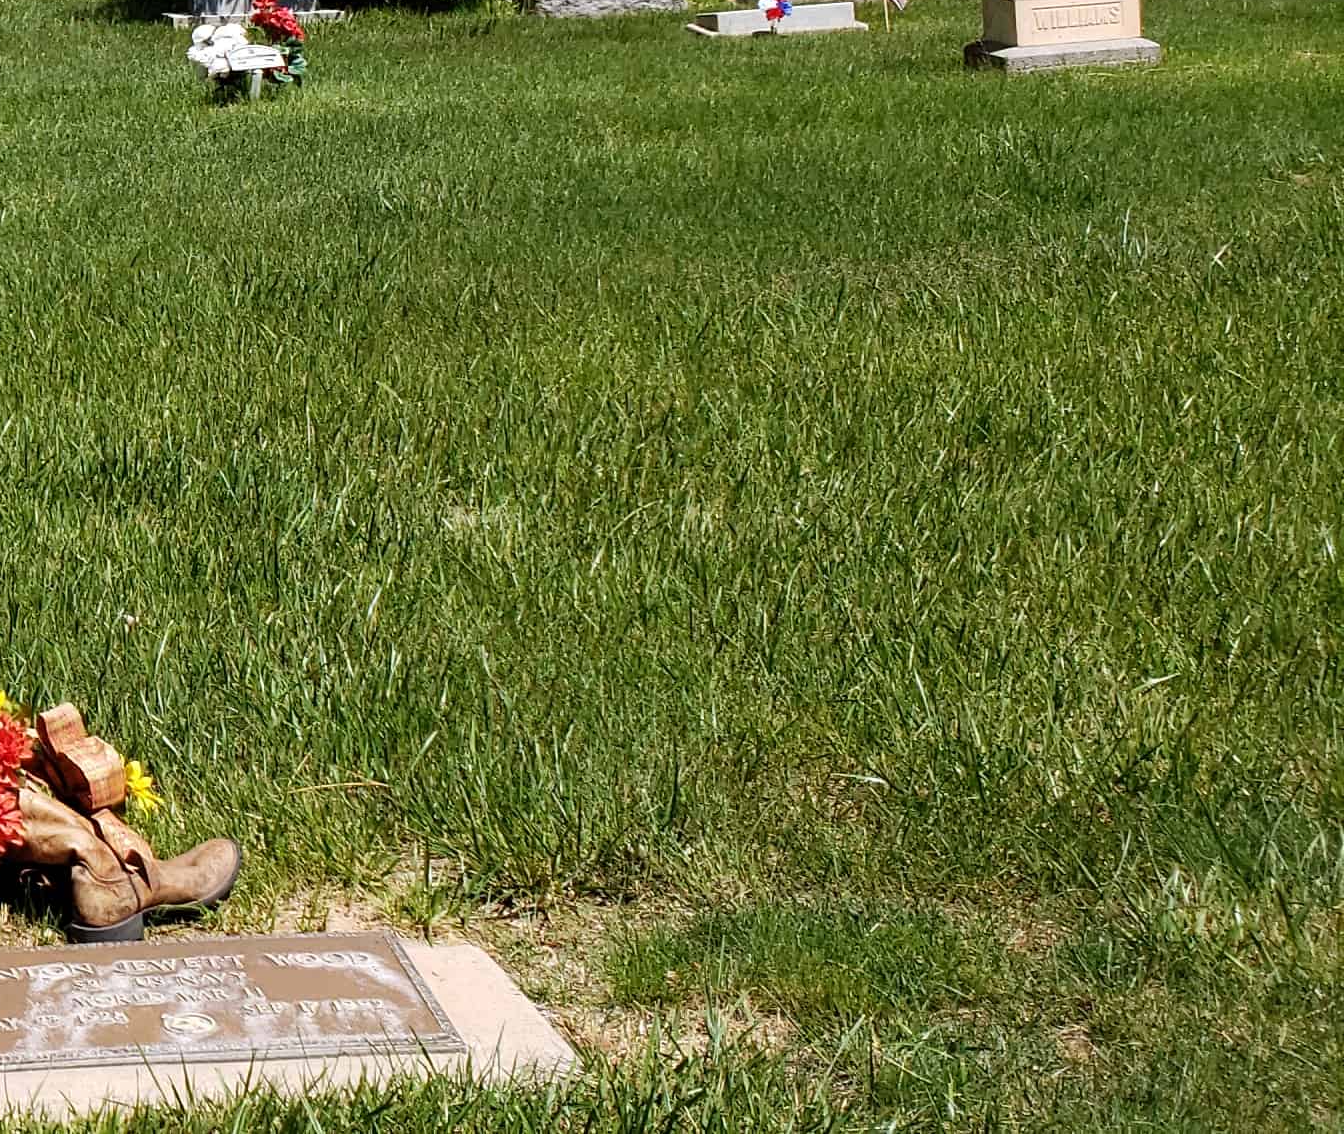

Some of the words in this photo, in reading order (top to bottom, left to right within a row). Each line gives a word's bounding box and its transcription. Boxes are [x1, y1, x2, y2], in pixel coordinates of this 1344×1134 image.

[113, 954, 245, 975] JEWETT
[262, 951, 372, 969] WOOD
[176, 972, 247, 986] NAVY
[176, 989, 230, 1002] WAR
